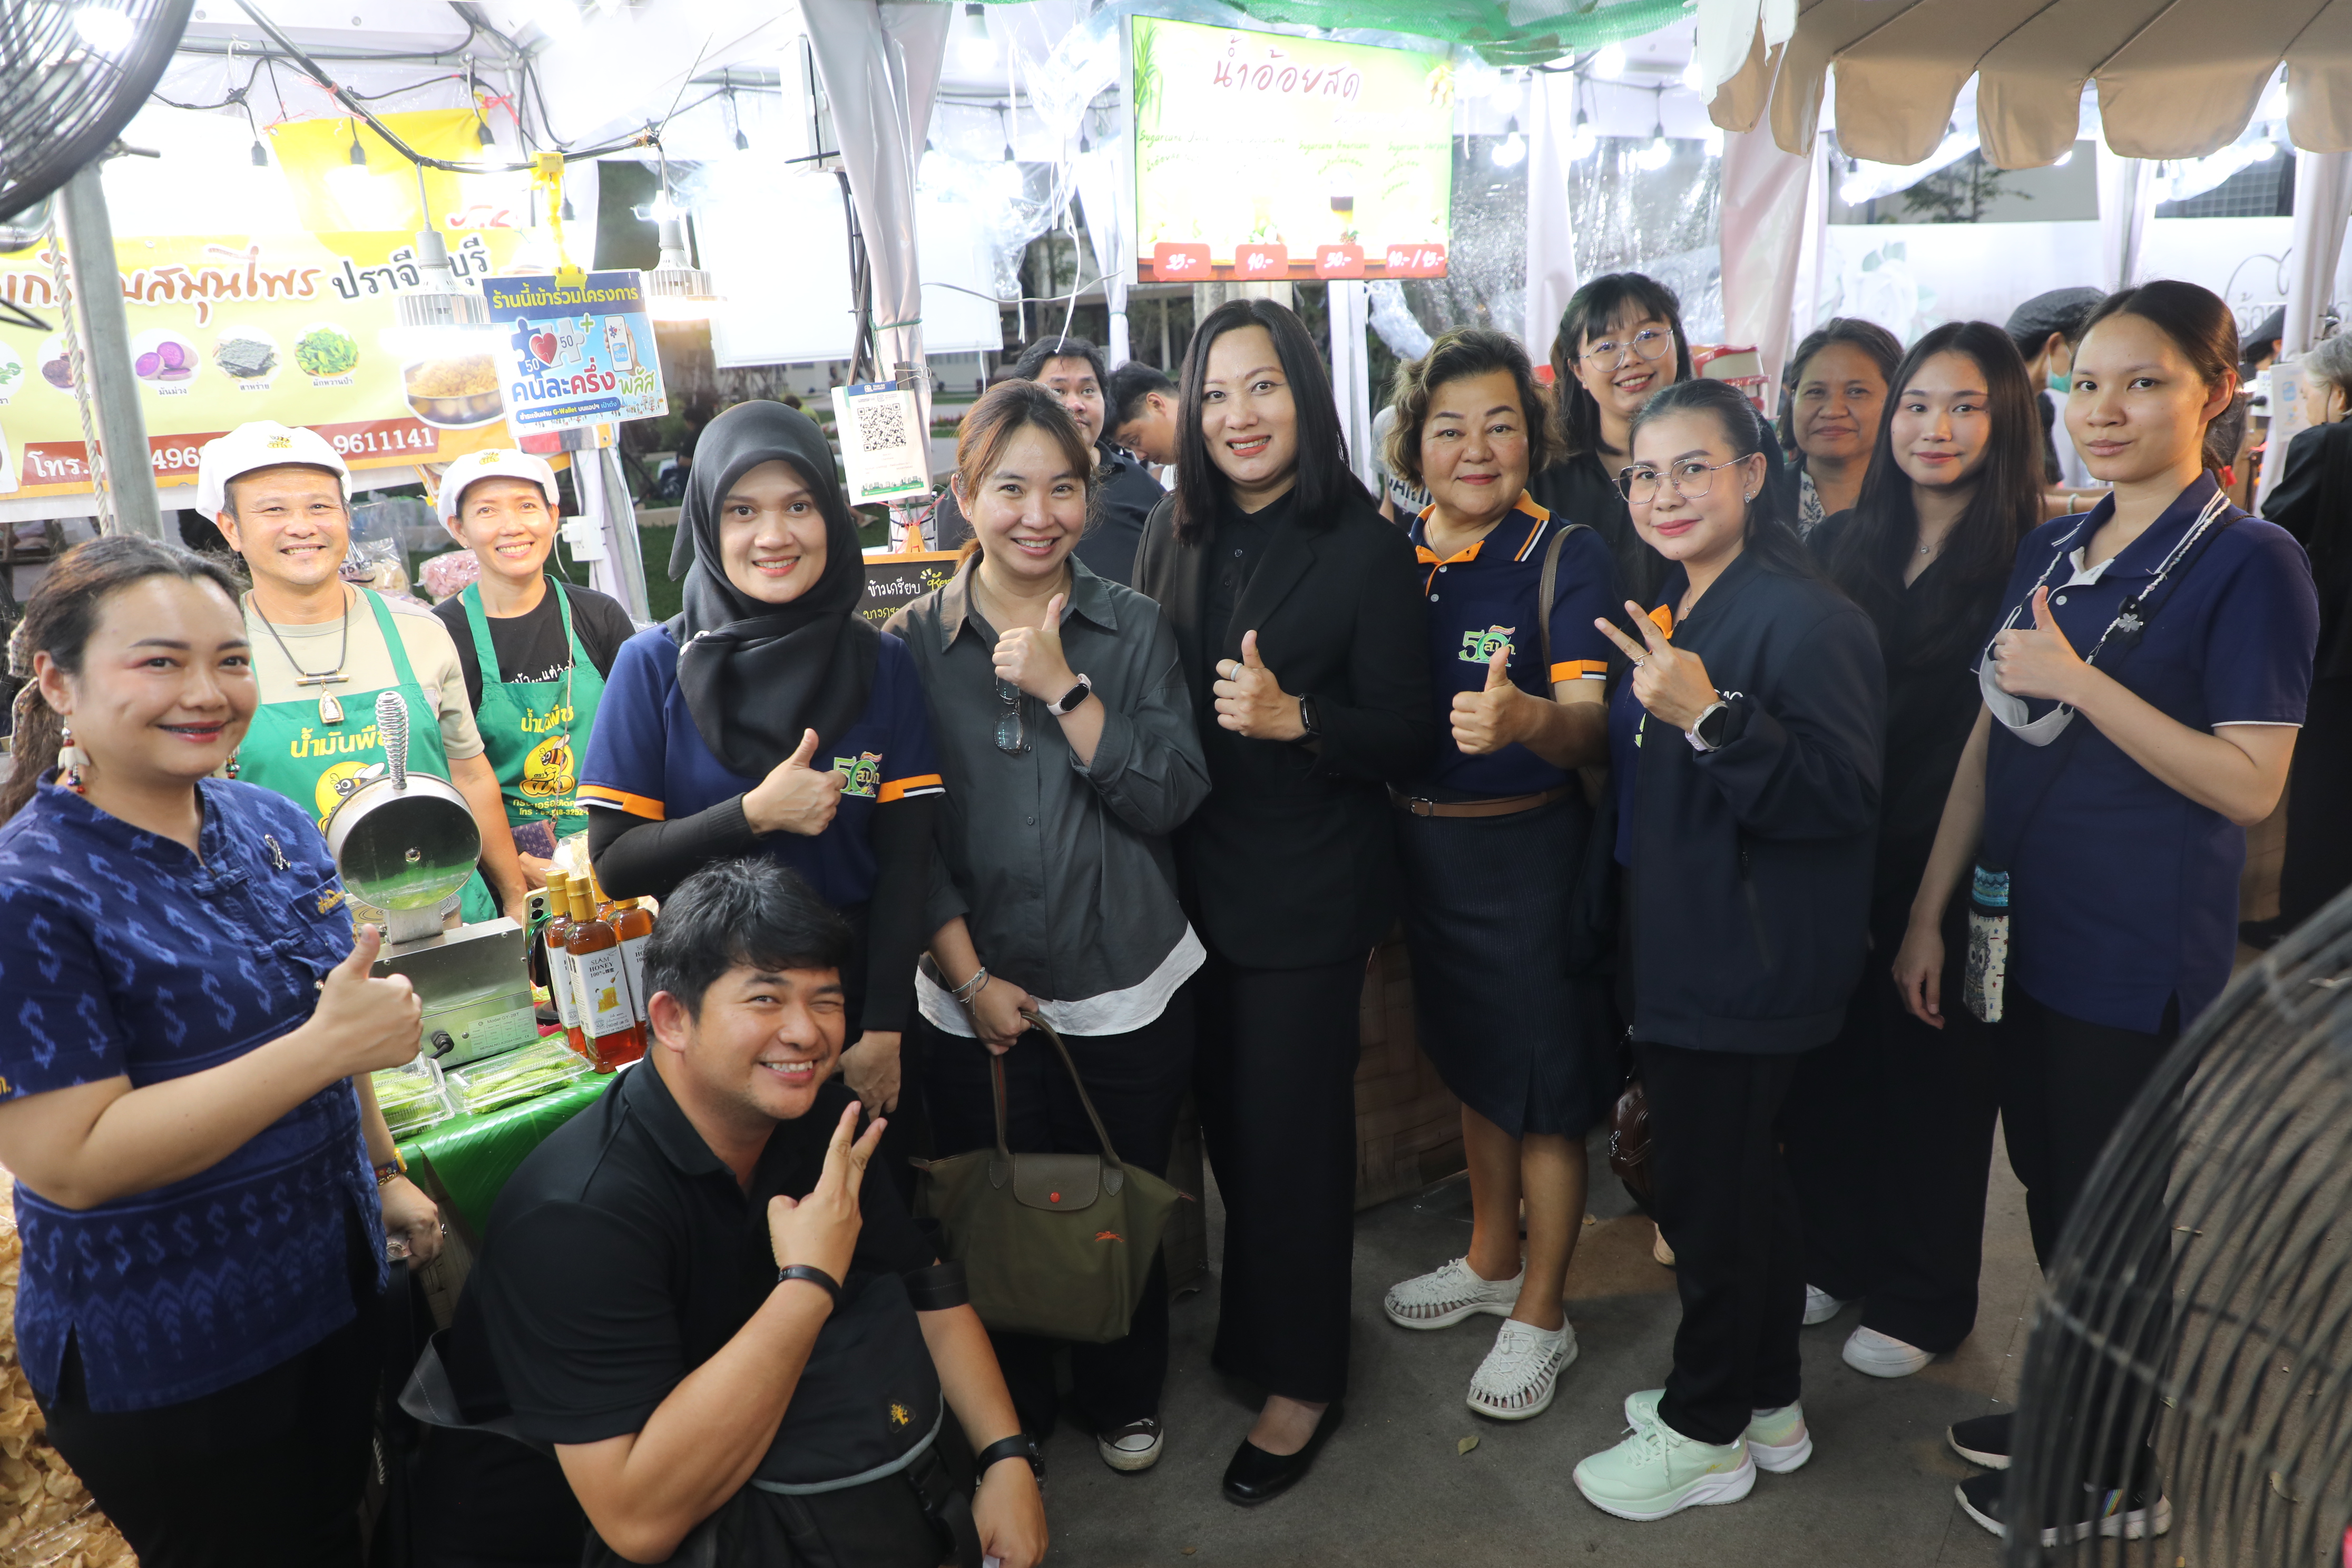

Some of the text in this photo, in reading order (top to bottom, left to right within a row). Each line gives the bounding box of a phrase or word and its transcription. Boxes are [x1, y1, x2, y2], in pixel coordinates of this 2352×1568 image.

[1213, 34, 1361, 102] น้ำอ้อยสด
[1166, 253, 1196, 270] 35.-
[1324, 251, 1351, 268] 50.-
[332, 236, 487, 300] ปราจีบุรี
[492, 282, 639, 310] ร้านนี้เข้าร่วมโครงการ
[560, 335, 574, 349] 50
[525, 358, 540, 373] 50
[239, 380, 270, 391] สาหร่าย
[512, 357, 656, 402] คนละครึ่ง พลัส
[159, 386, 188, 396] มันม่วง
[553, 406, 577, 416] G-Wallet
[151, 446, 205, 469] 496
[867, 576, 920, 597] ข้าวเกรียบ
[863, 606, 900, 620] บางกร
[589, 961, 613, 972] HONEY
[591, 956, 610, 966] SIAM
